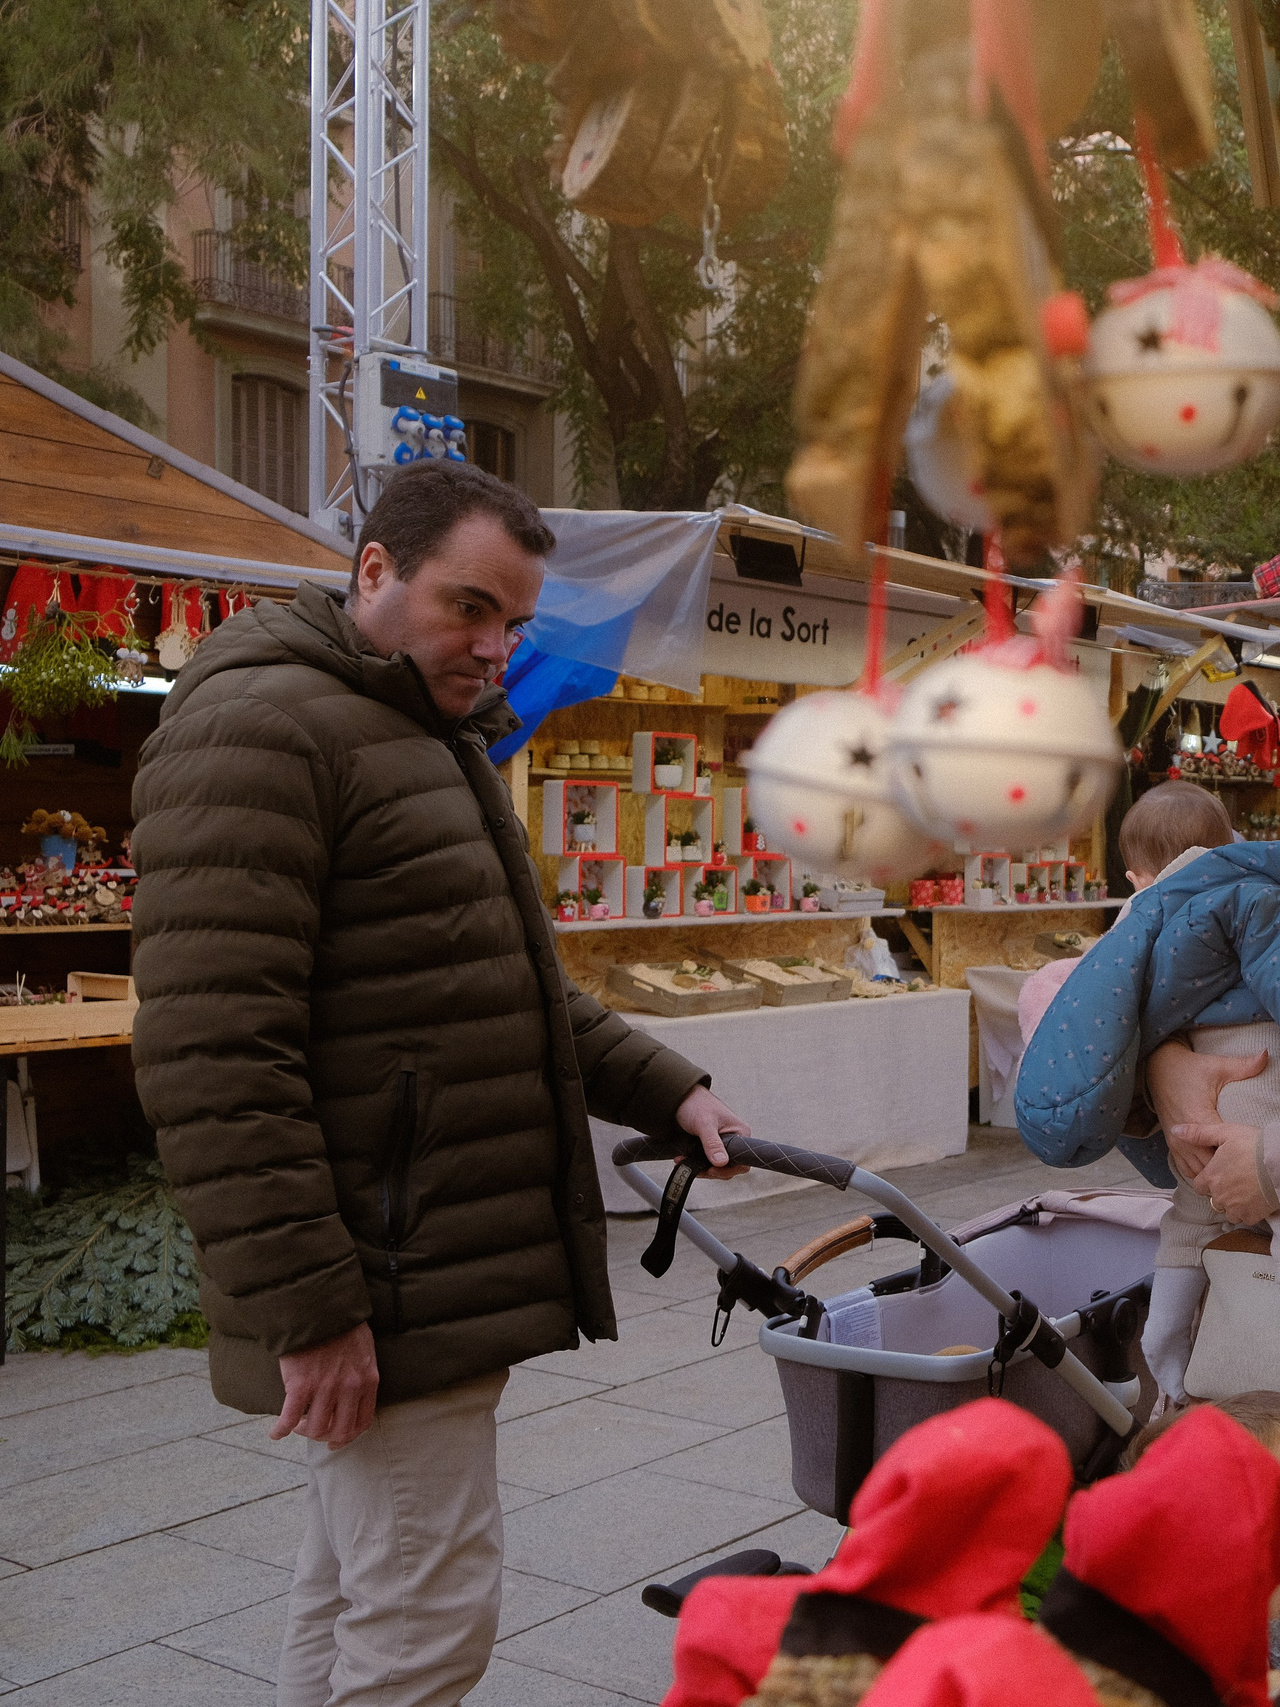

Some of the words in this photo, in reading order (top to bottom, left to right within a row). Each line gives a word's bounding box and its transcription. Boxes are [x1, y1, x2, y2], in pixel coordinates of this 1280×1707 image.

[707, 603, 742, 635] de
[750, 607, 772, 639] la
[780, 605, 830, 646] Sort
